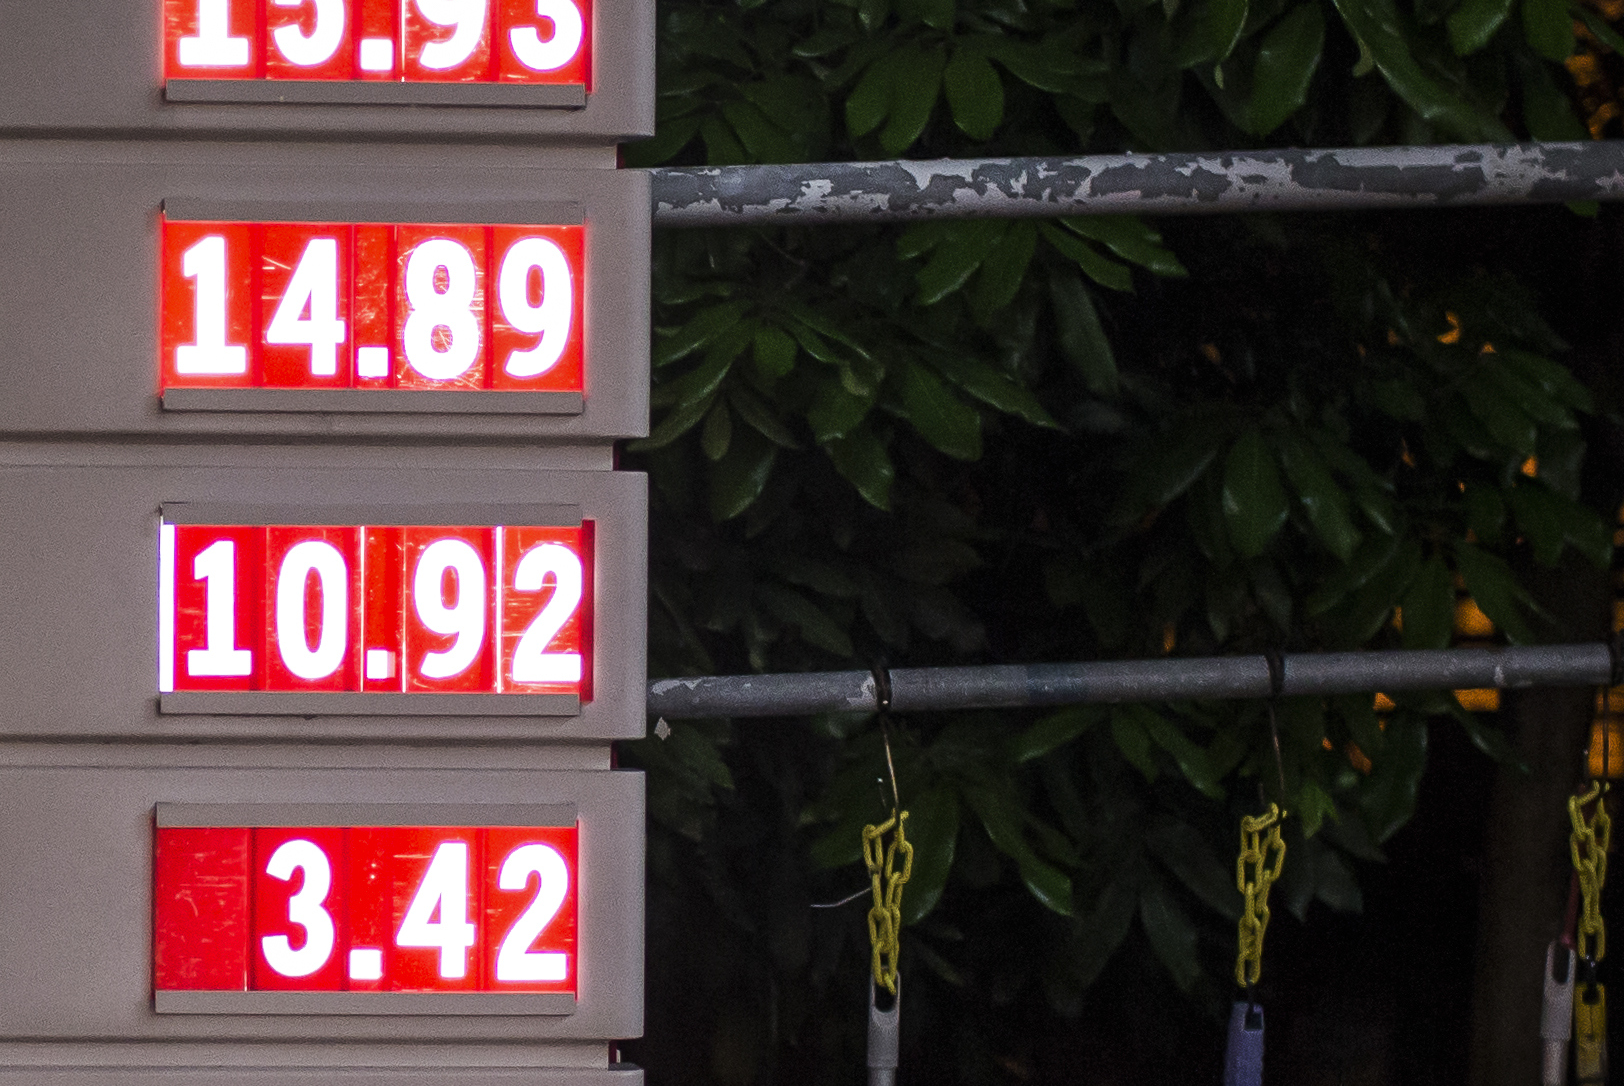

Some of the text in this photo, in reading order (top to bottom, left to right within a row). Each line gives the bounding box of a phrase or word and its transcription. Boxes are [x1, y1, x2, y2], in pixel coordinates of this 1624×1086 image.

[176, 236, 573, 379] 14.89
[187, 539, 584, 682] 10.92
[261, 839, 570, 981] 3.42
